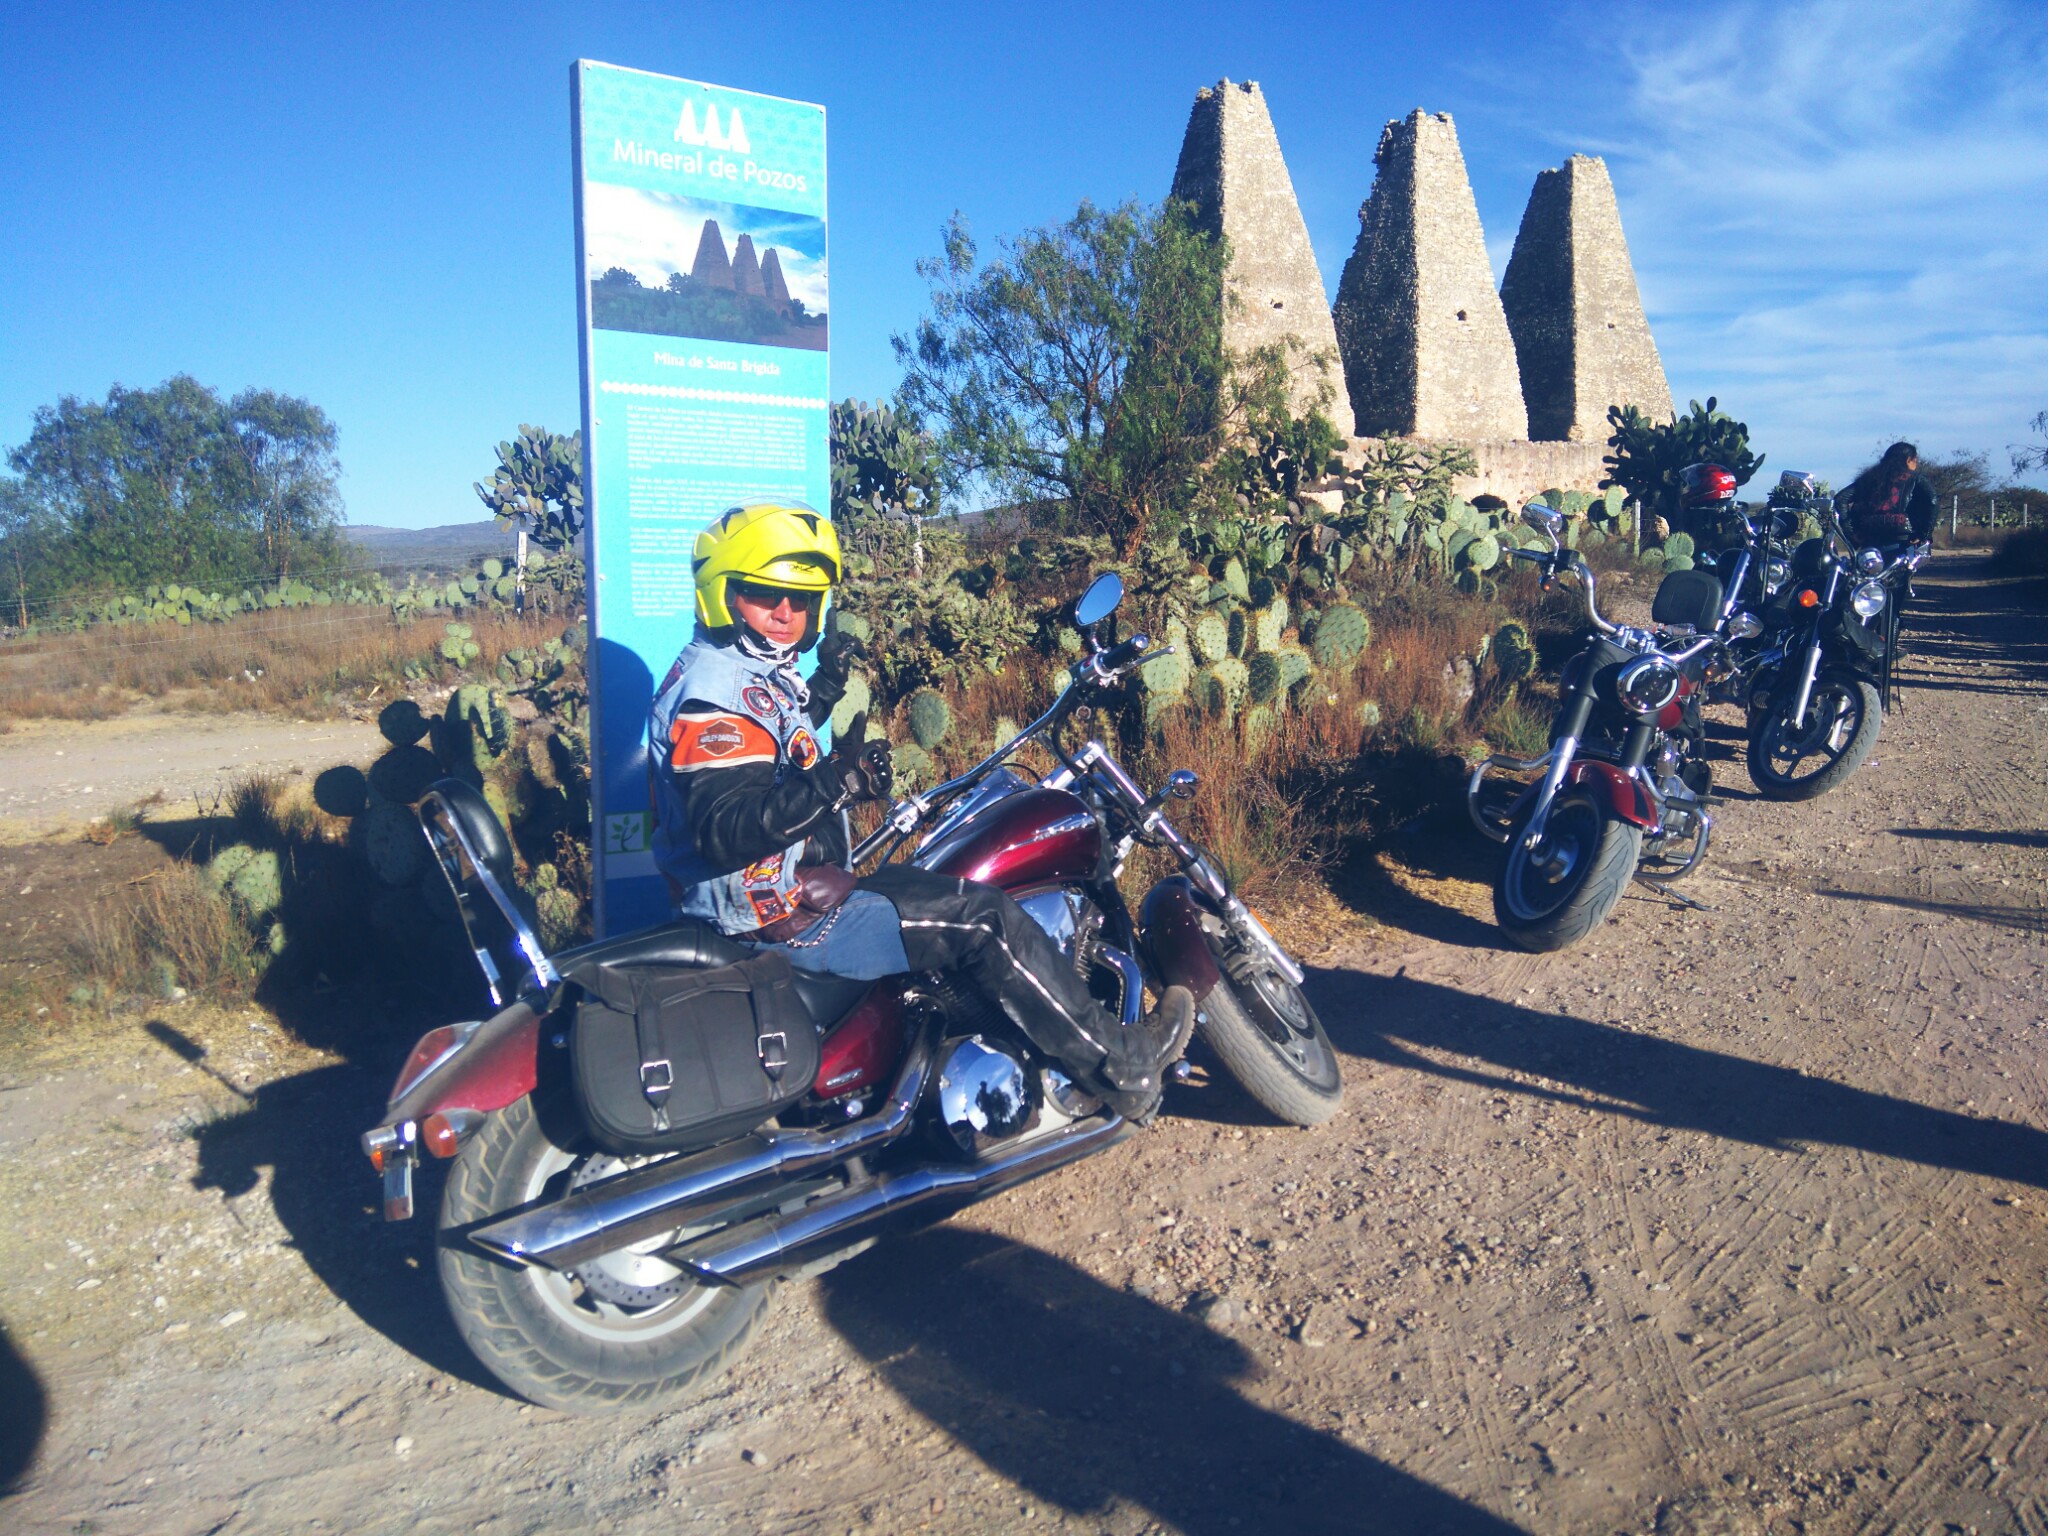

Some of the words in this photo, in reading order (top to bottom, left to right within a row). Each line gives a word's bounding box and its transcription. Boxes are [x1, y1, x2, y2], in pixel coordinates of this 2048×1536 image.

[613, 138, 701, 175] Mineral
[708, 154, 738, 180] de
[744, 160, 807, 192] Pozos
[653, 351, 686, 368] Mina
[688, 354, 704, 369] de
[705, 355, 738, 372] Santa
